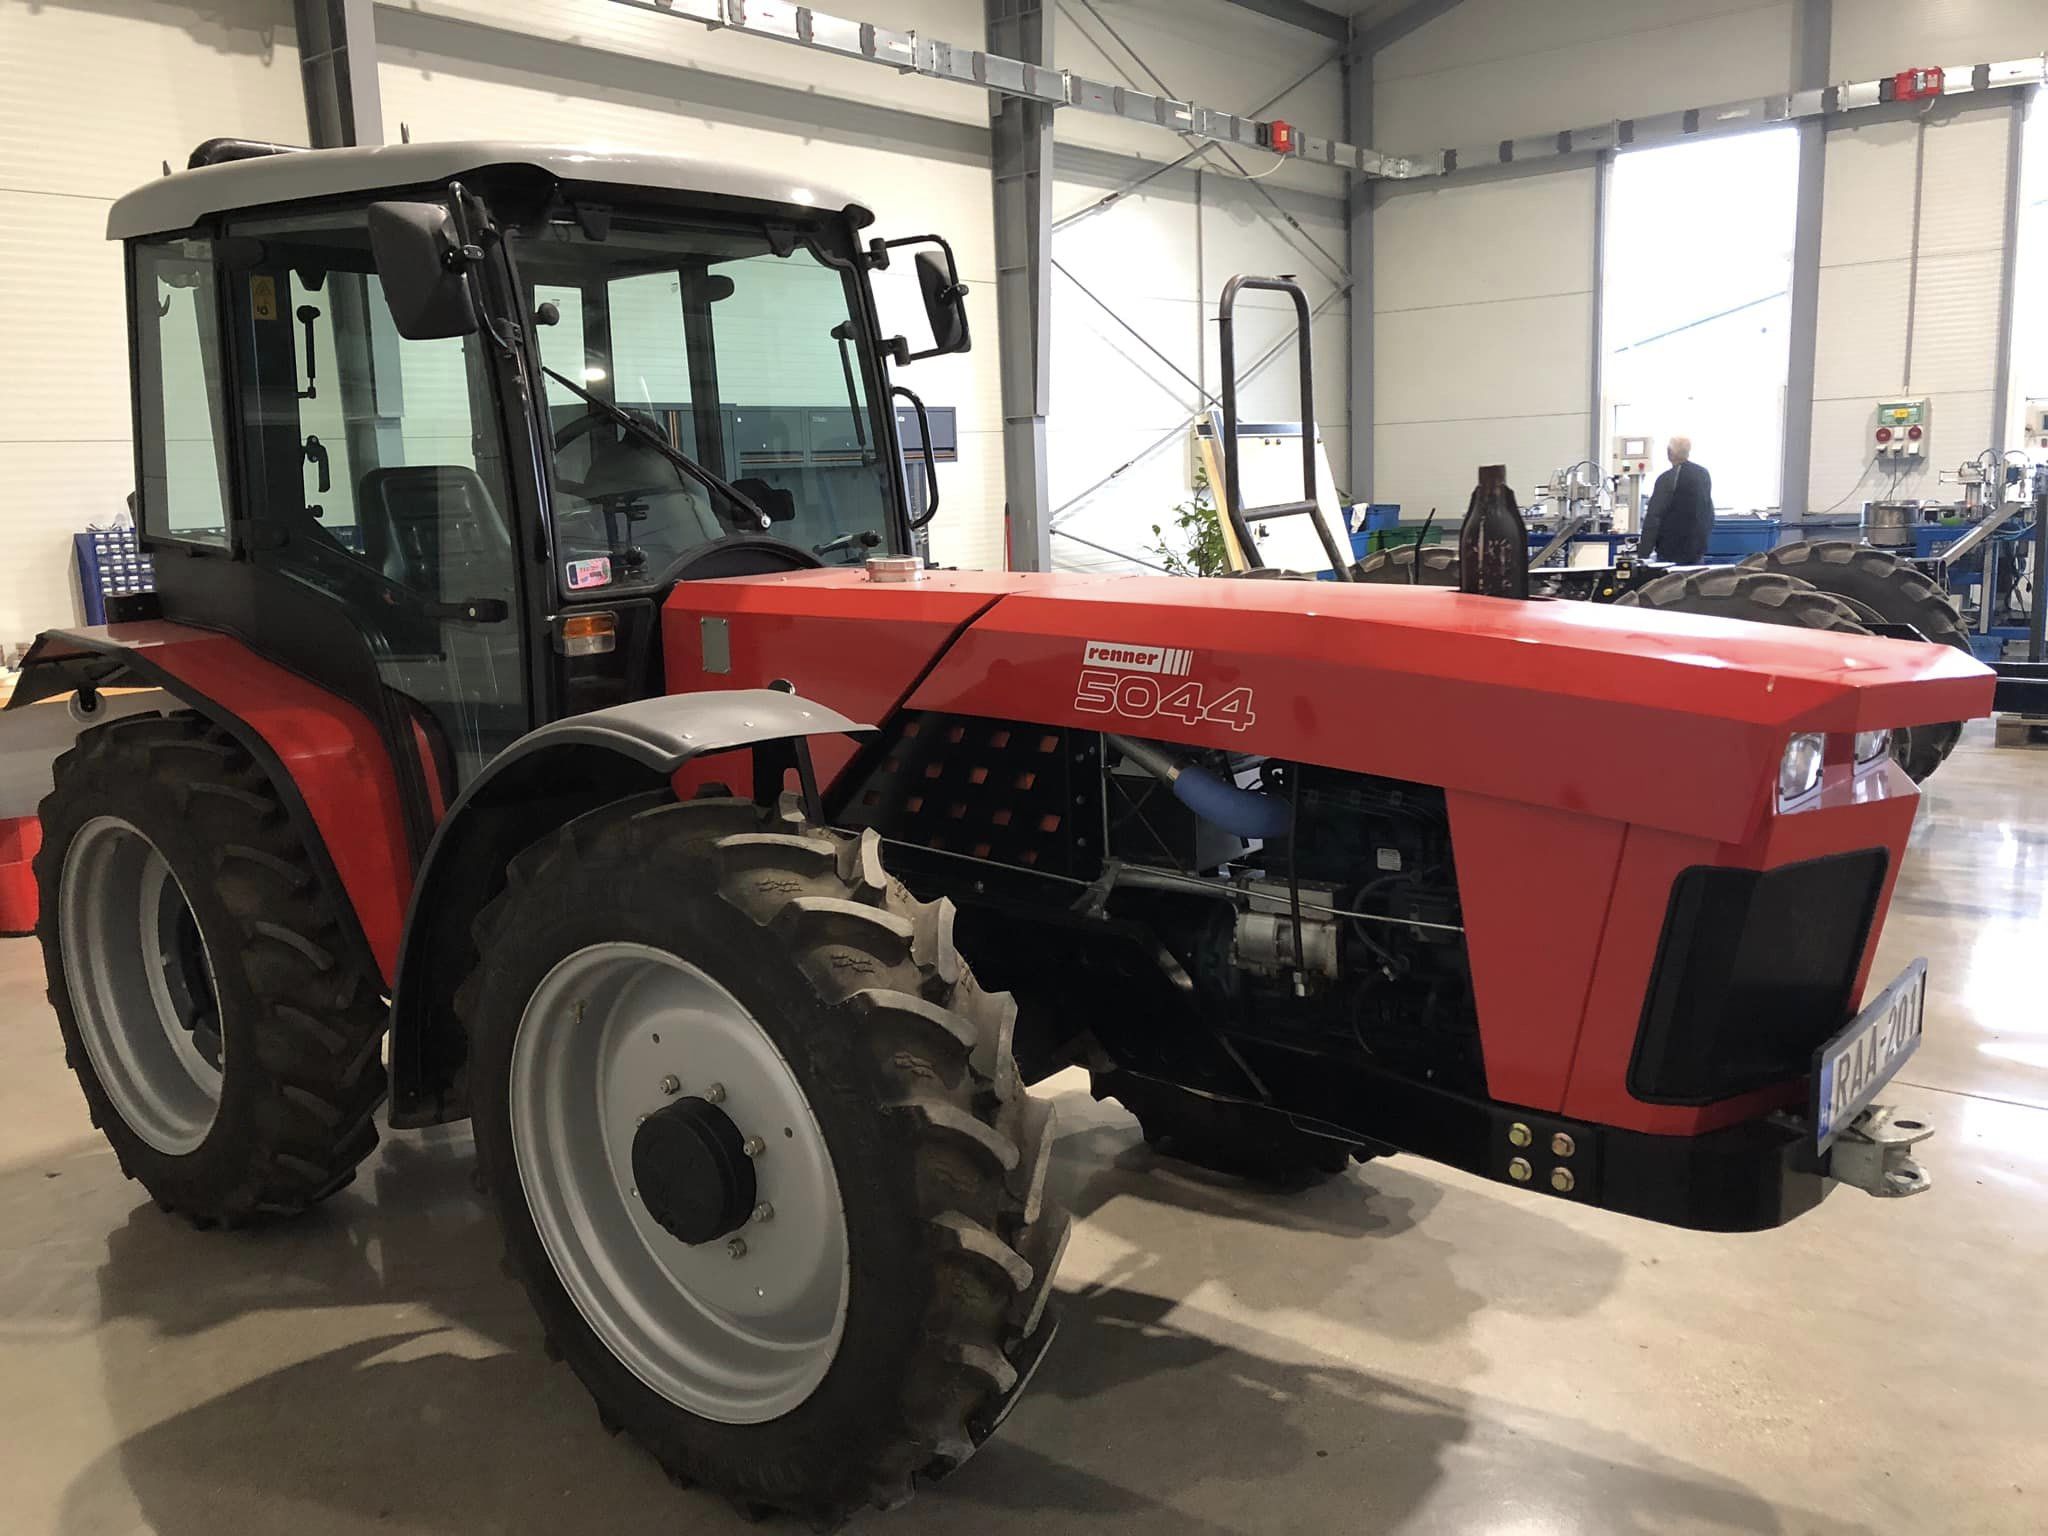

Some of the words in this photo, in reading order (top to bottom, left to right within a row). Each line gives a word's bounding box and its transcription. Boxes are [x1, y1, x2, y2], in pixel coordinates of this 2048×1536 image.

[1088, 646, 1159, 666] renner
[1074, 669, 1256, 732] 5044
[1834, 983, 1919, 1114] RAA-201
